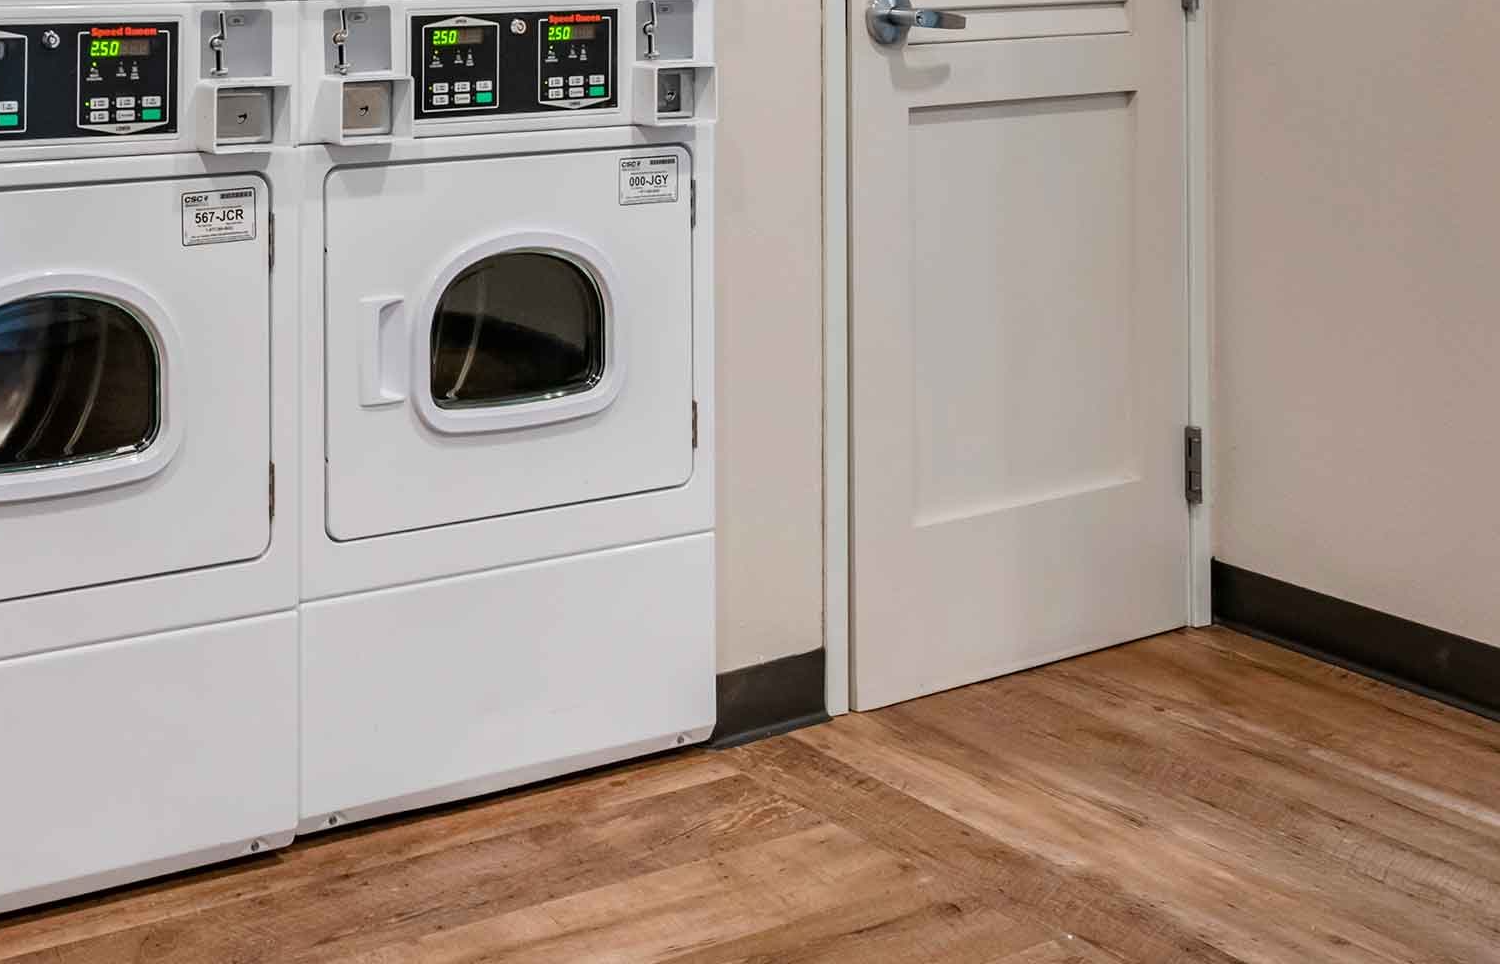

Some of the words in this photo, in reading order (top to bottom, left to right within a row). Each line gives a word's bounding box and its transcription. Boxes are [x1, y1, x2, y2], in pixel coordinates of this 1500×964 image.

[90, 28, 124, 38] Speed
[124, 27, 157, 36] Queen
[90, 40, 120, 56] 2.50
[629, 174, 669, 187] 000-JGY
[184, 196, 203, 204] CSC
[196, 208, 244, 224] 567-JCR
